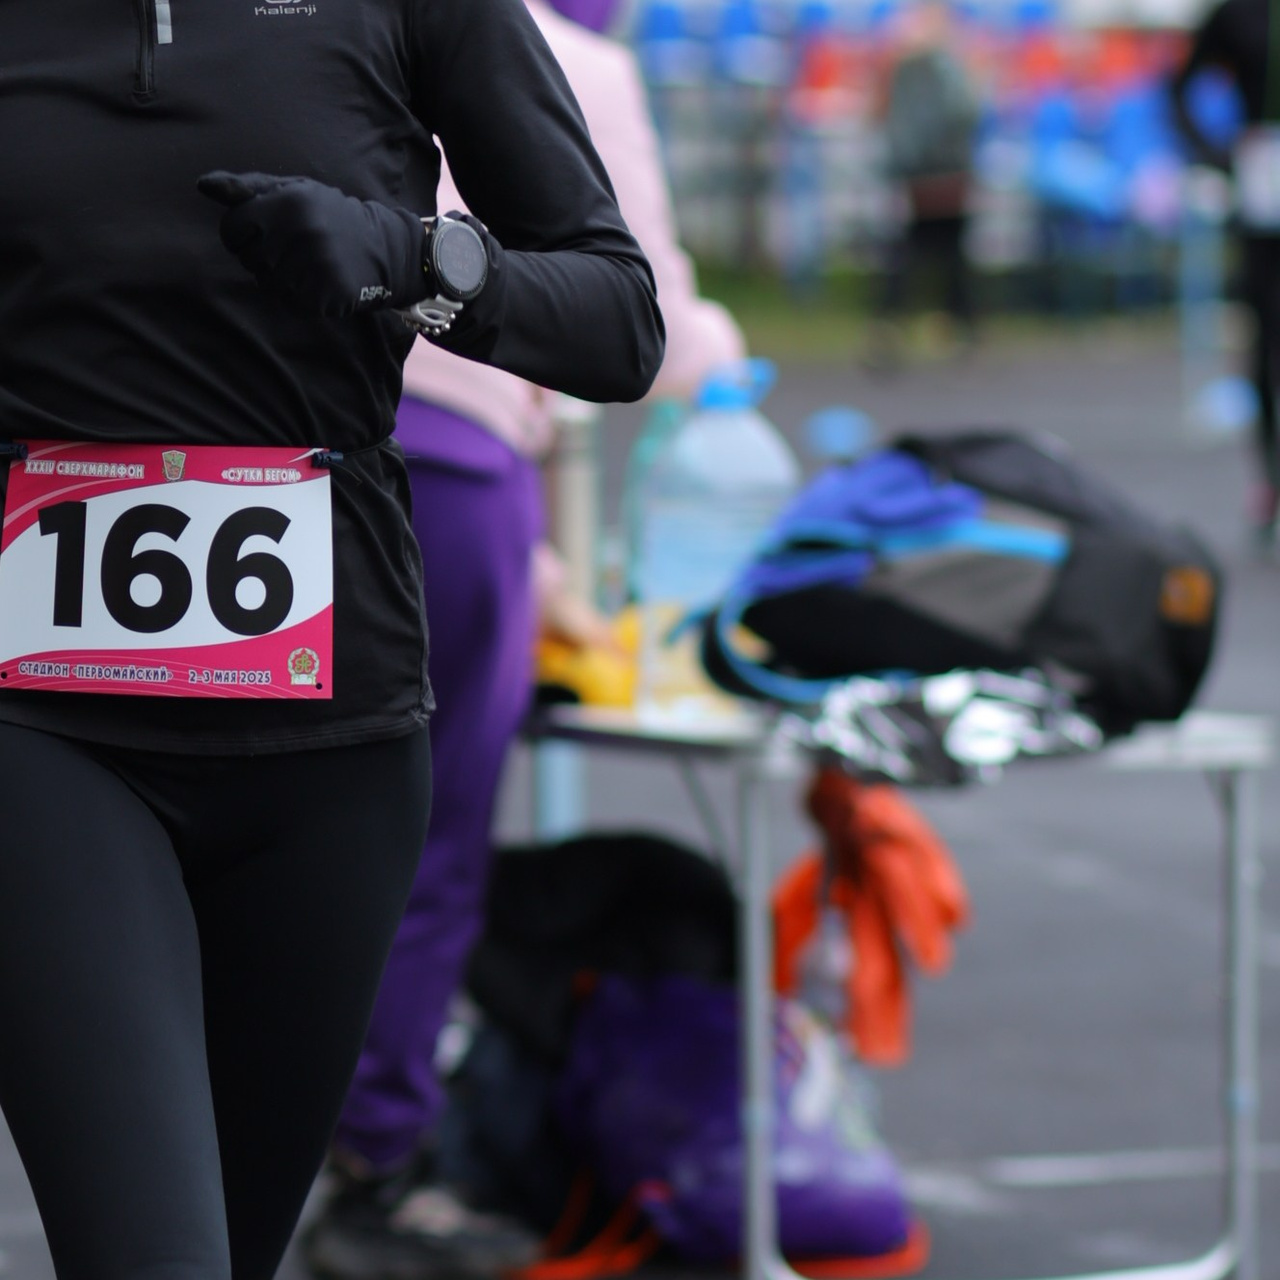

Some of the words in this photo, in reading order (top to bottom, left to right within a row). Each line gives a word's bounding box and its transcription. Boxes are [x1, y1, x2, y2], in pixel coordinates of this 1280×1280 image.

[254, 4, 317, 17] Kalenji
[56, 461, 144, 479] СВЕРХМАРАФОН
[38, 500, 294, 636] 166
[19, 661, 69, 677] СТАДИОН
[72, 664, 173, 682] «ПЕРВОМАЙСКИЙ»
[213, 670, 238, 683] МАЯ
[239, 671, 271, 685] 2025
